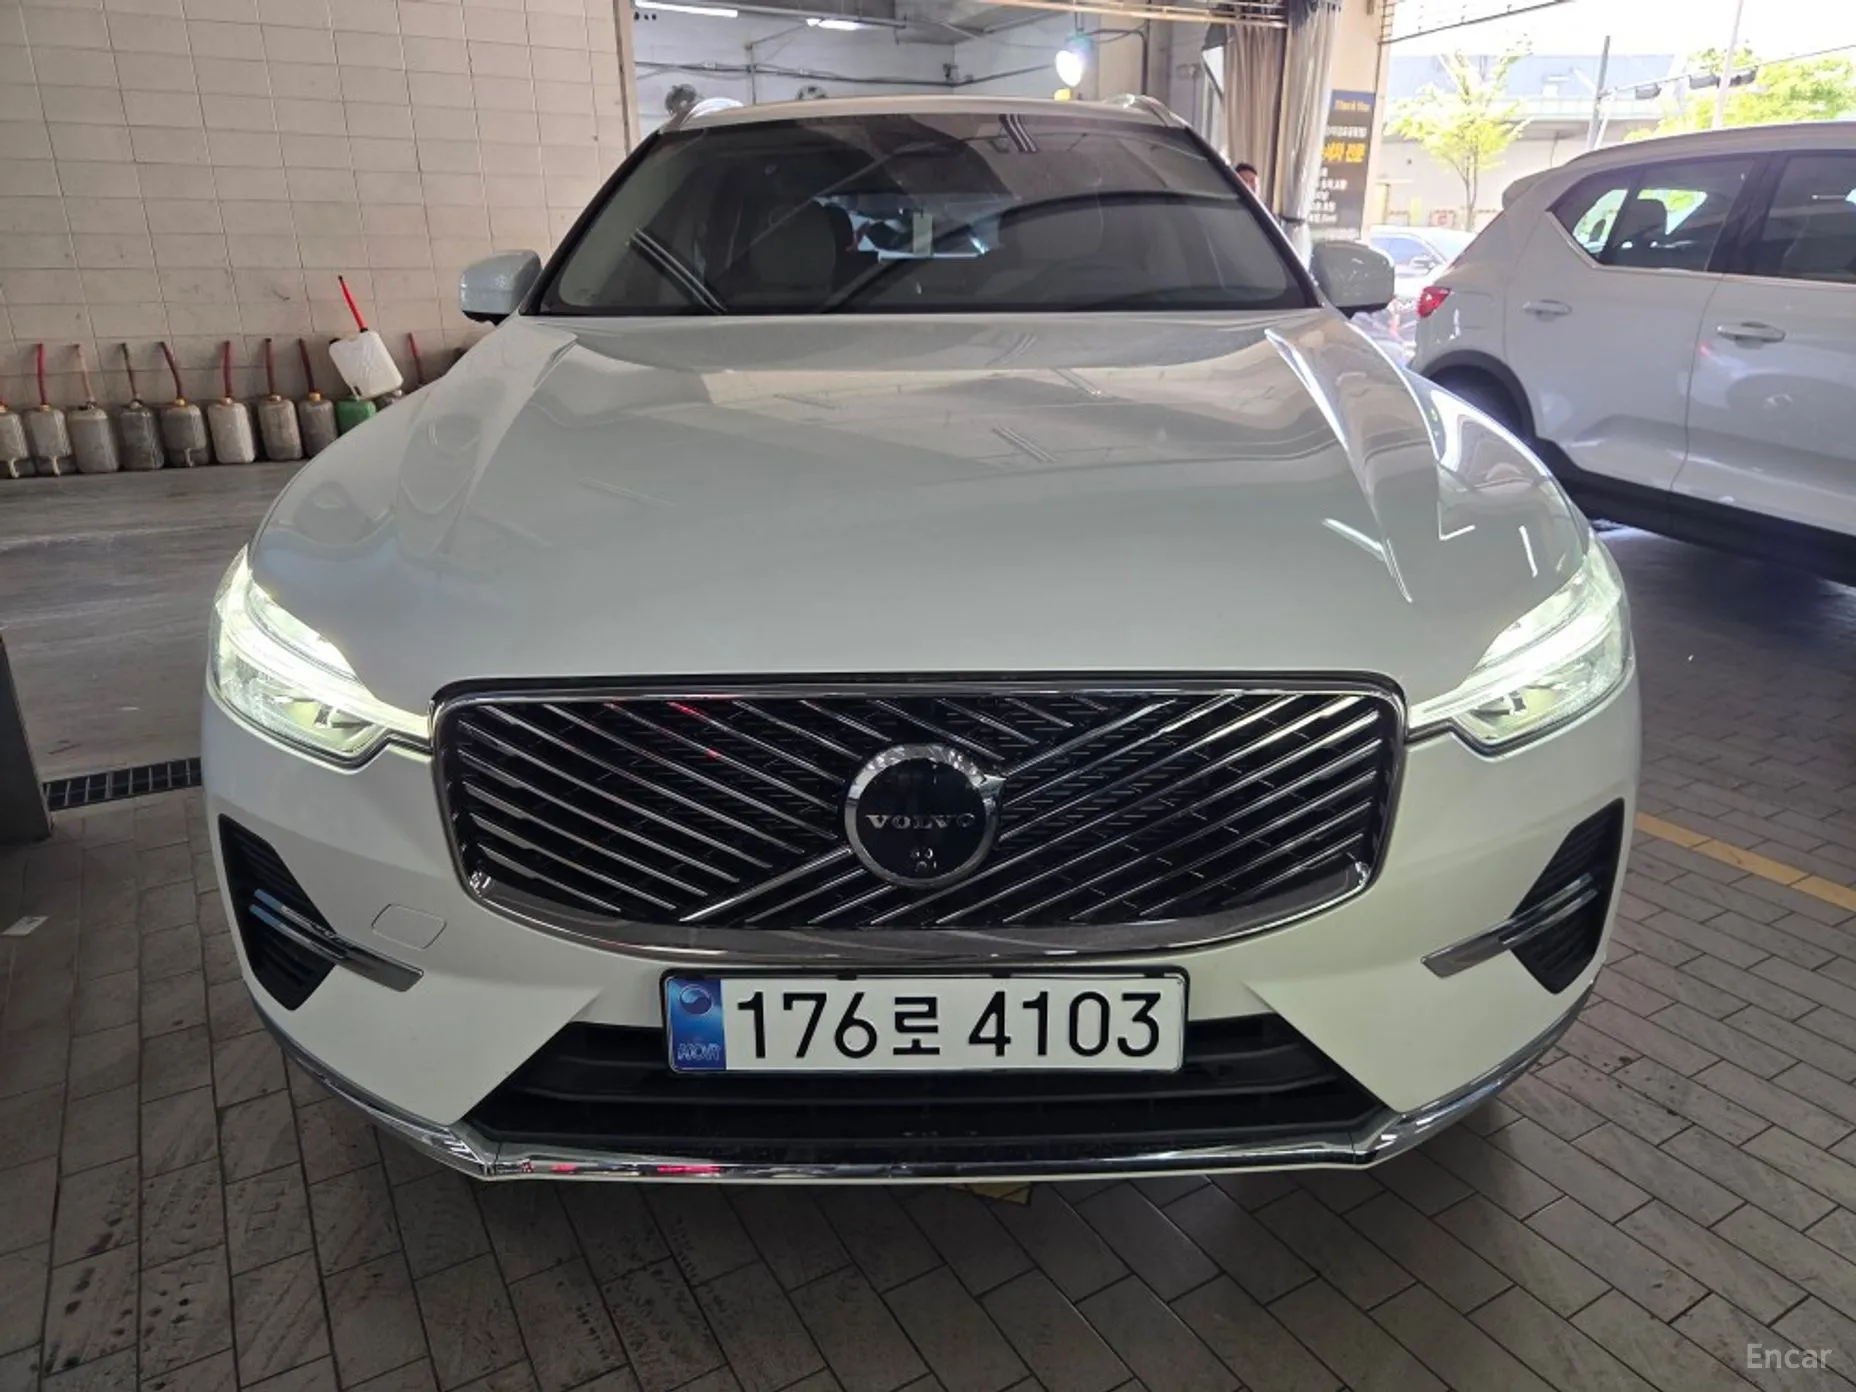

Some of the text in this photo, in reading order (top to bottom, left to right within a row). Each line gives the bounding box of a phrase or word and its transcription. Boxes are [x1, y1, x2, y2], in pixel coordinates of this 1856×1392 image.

[865, 812, 976, 829] VOLVO
[737, 991, 1162, 1059] 176로 4103
